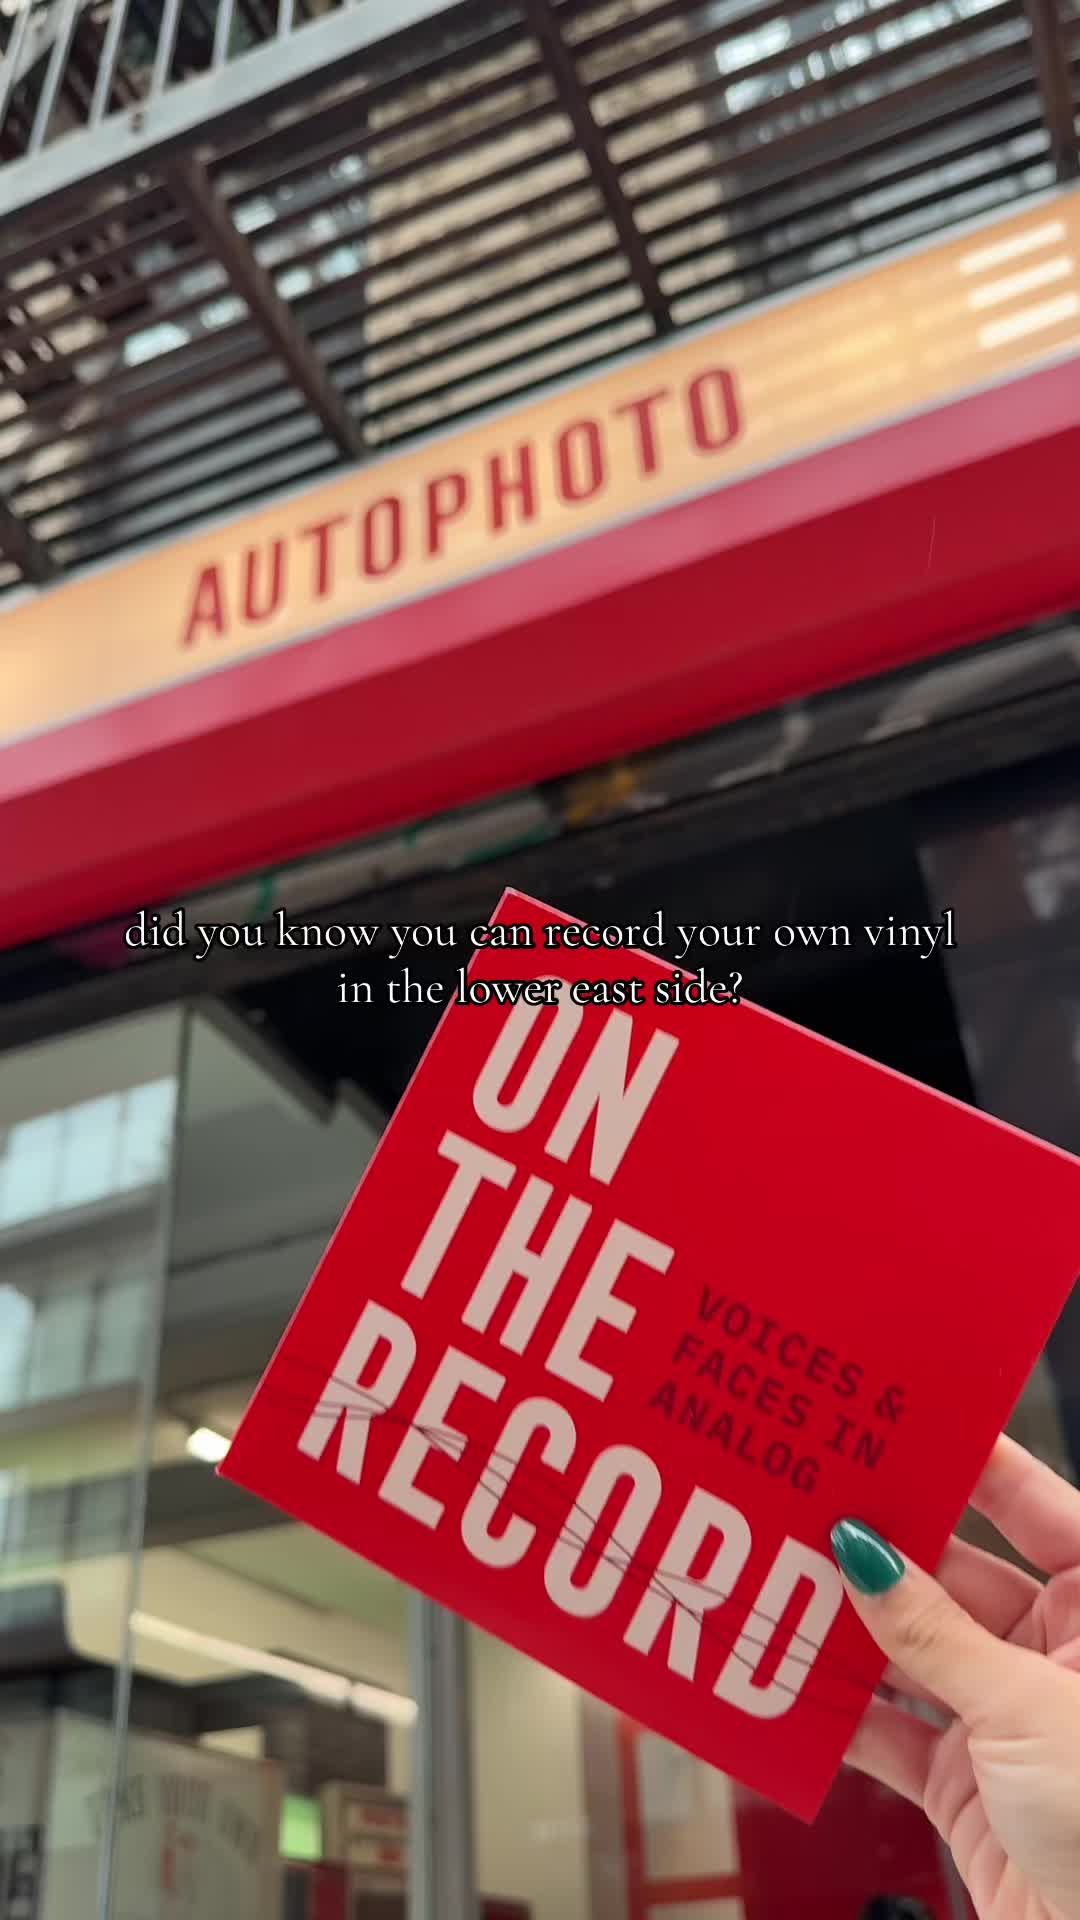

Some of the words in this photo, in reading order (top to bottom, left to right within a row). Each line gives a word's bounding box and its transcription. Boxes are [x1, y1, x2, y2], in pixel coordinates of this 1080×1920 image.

[181, 367, 744, 649] AUTOPHOTO
[472, 975, 679, 1186] ON
[400, 1129, 675, 1403] THE
[697, 1283, 863, 1397] VOICES
[874, 1385, 905, 1424] &
[646, 1378, 820, 1494] ANALOG
[671, 1332, 812, 1429] FACES
[824, 1415, 886, 1470] IN
[297, 1299, 844, 1720] RECORD
